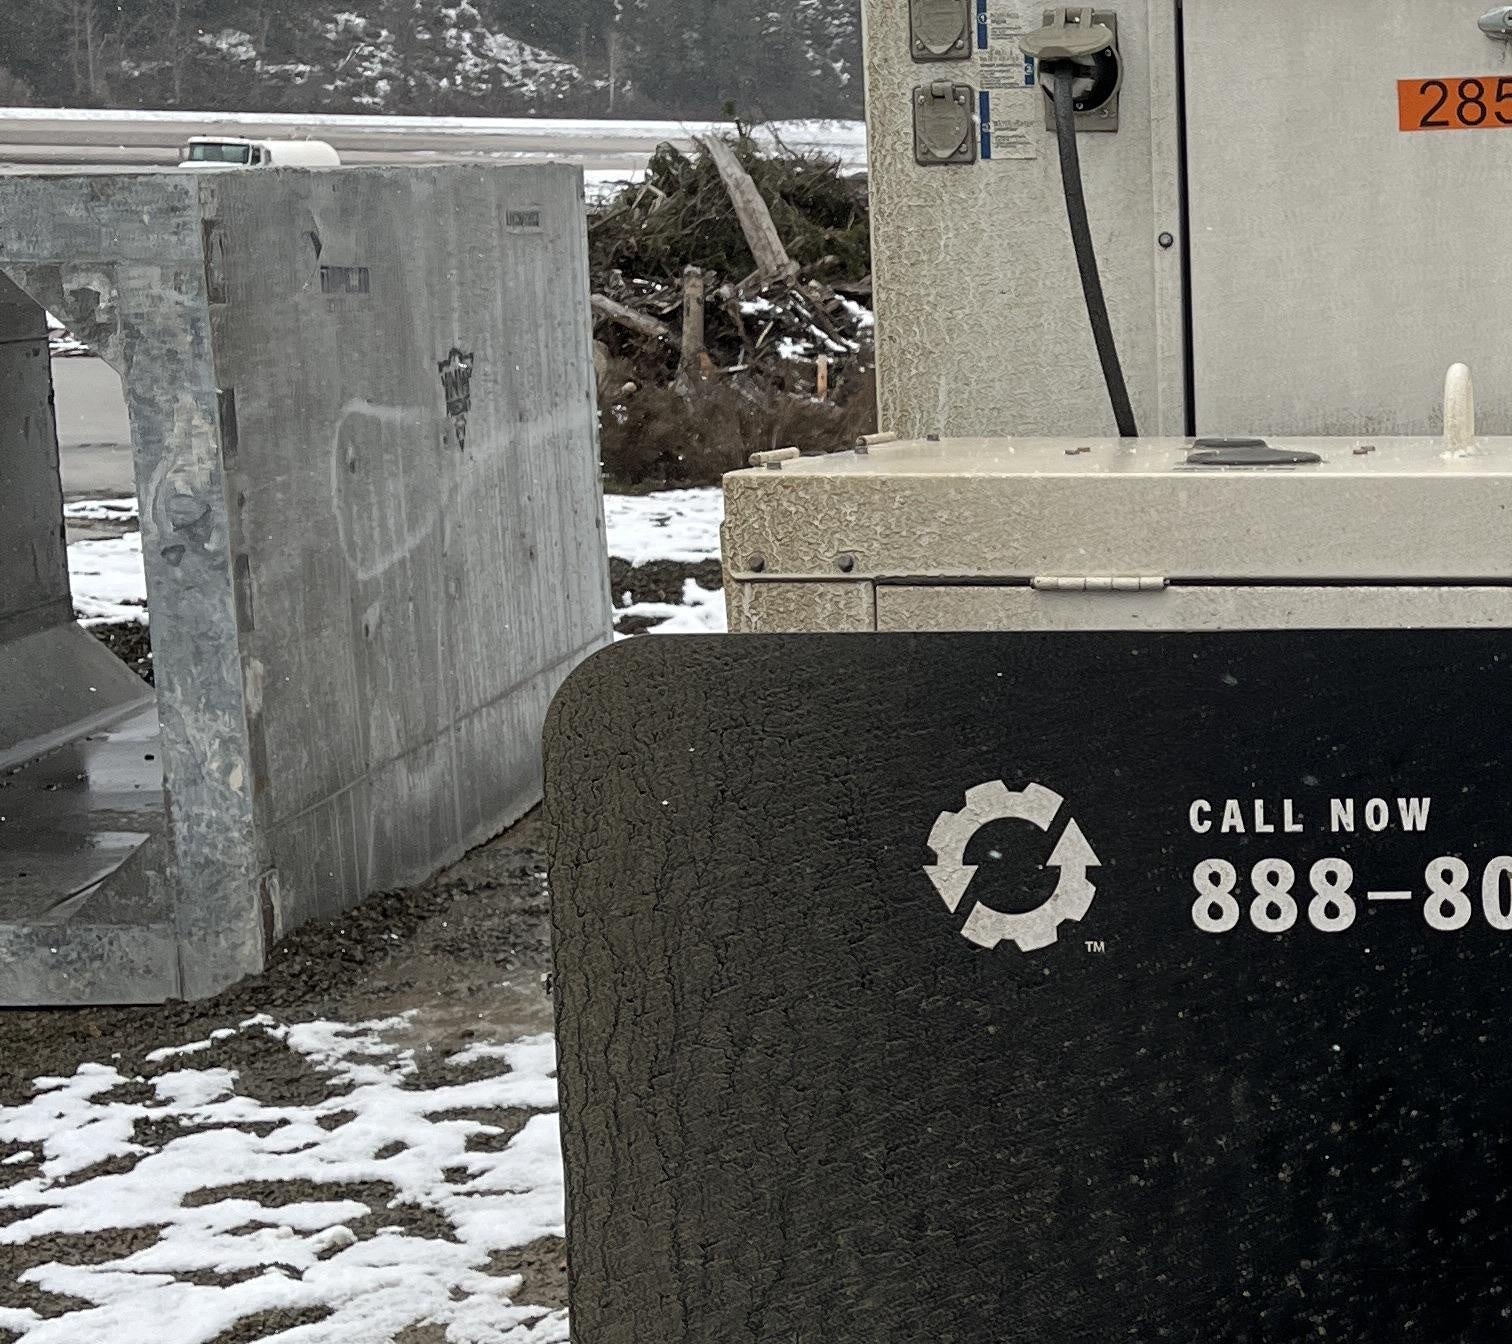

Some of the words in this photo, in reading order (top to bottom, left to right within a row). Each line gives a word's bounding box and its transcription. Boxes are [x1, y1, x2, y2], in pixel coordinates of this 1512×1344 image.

[1189, 798, 1304, 834] CALL
[1331, 797, 1431, 833] NOW
[1084, 940, 1105, 953] TM
